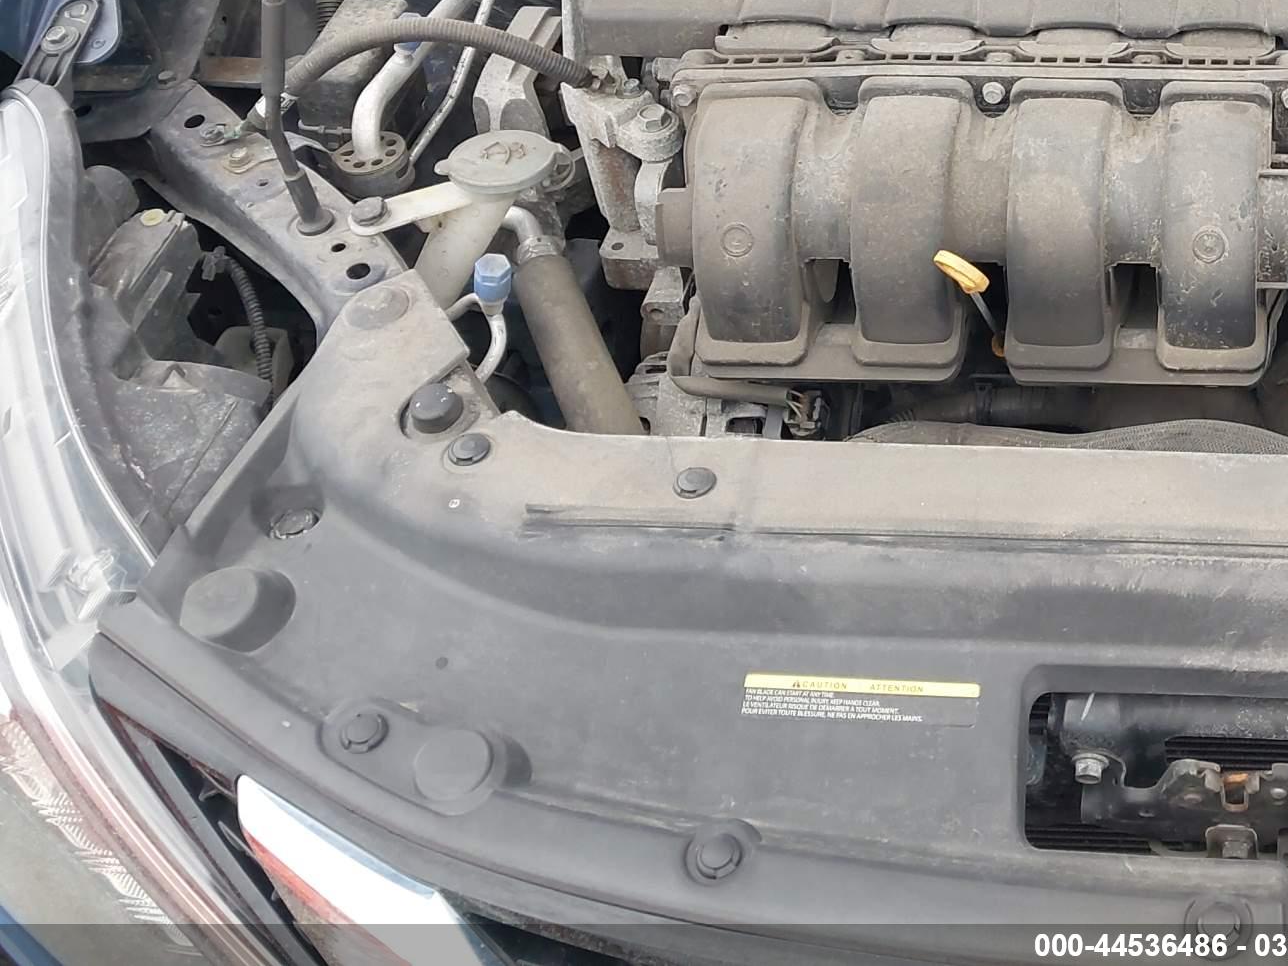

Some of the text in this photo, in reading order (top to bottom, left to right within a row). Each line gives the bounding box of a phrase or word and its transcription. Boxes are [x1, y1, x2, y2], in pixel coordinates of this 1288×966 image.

[802, 681, 847, 690] CAUTION
[870, 684, 923, 692] ATTENTION
[856, 713, 892, 721] APPROCHER
